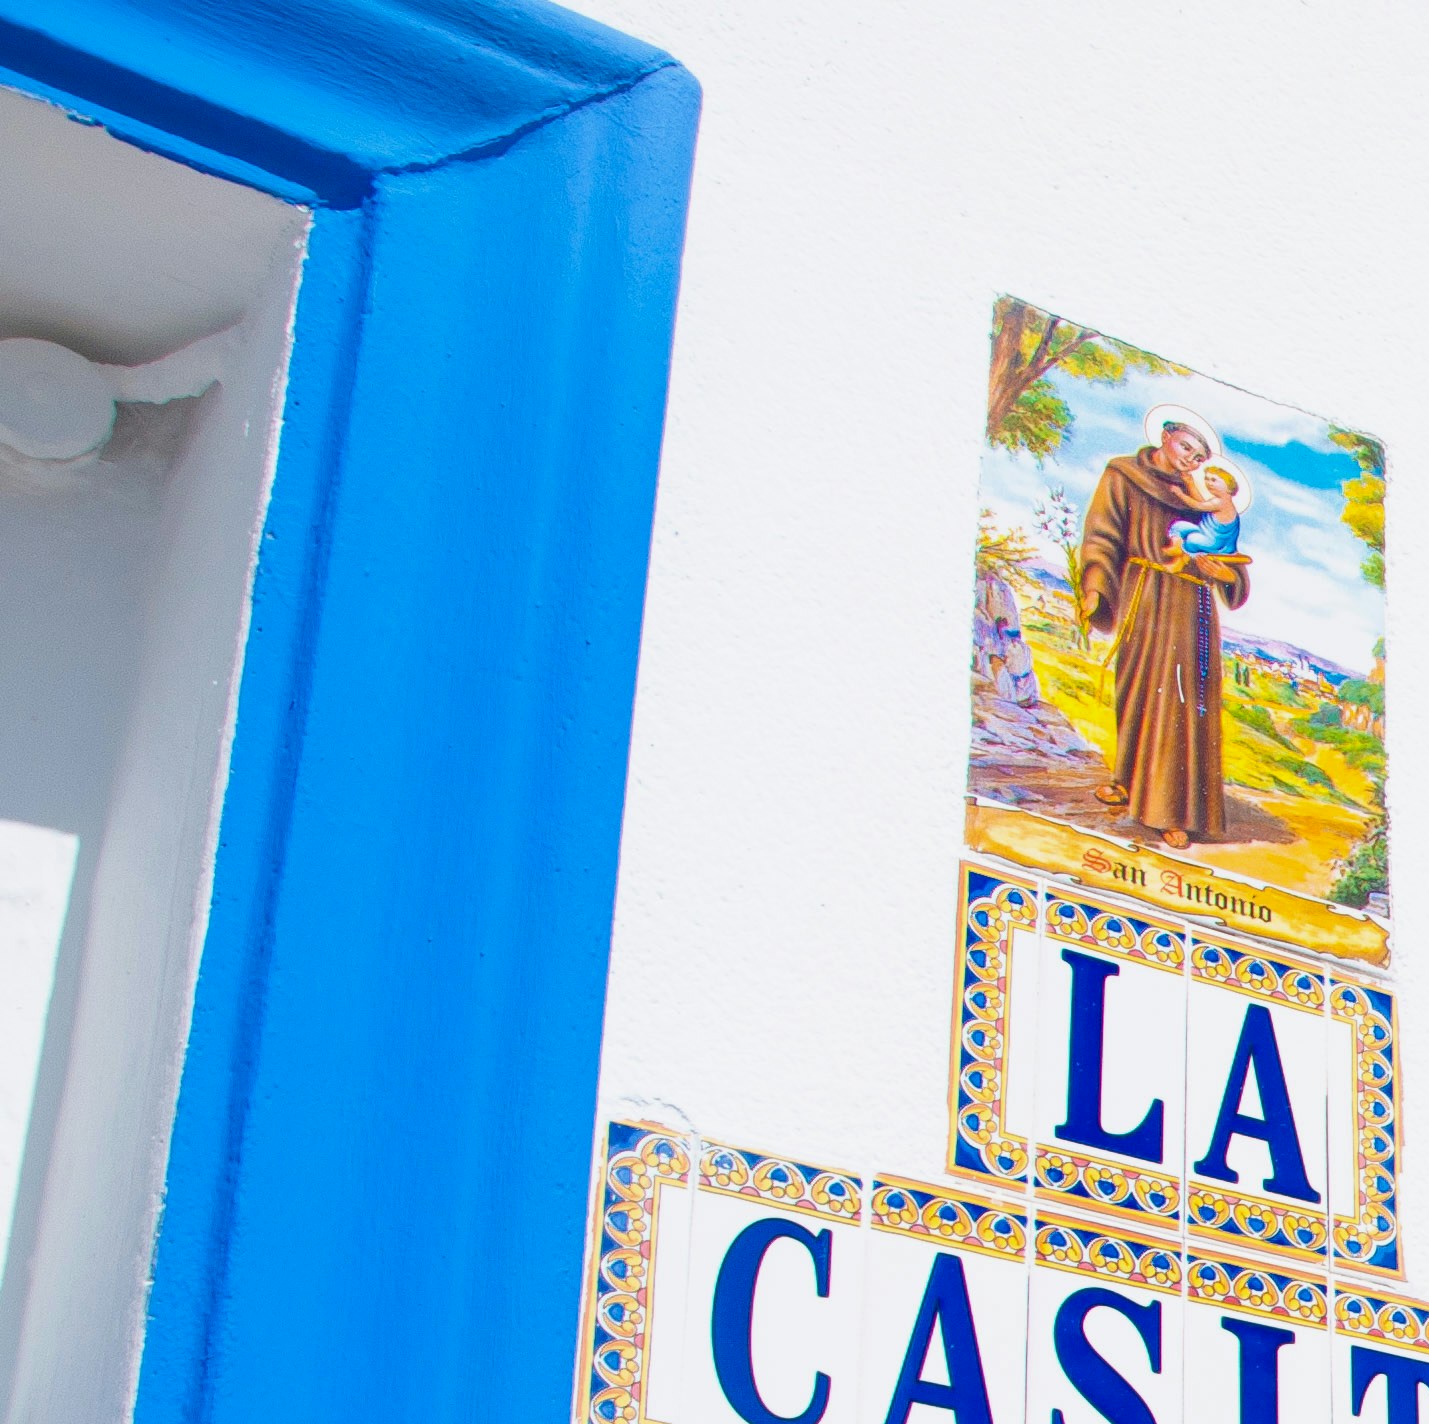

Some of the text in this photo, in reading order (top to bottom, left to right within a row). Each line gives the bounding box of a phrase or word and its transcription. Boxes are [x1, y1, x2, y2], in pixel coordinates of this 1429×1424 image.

[1082, 848, 1273, 923] San Antonio
[1054, 947, 1322, 1204] LA
